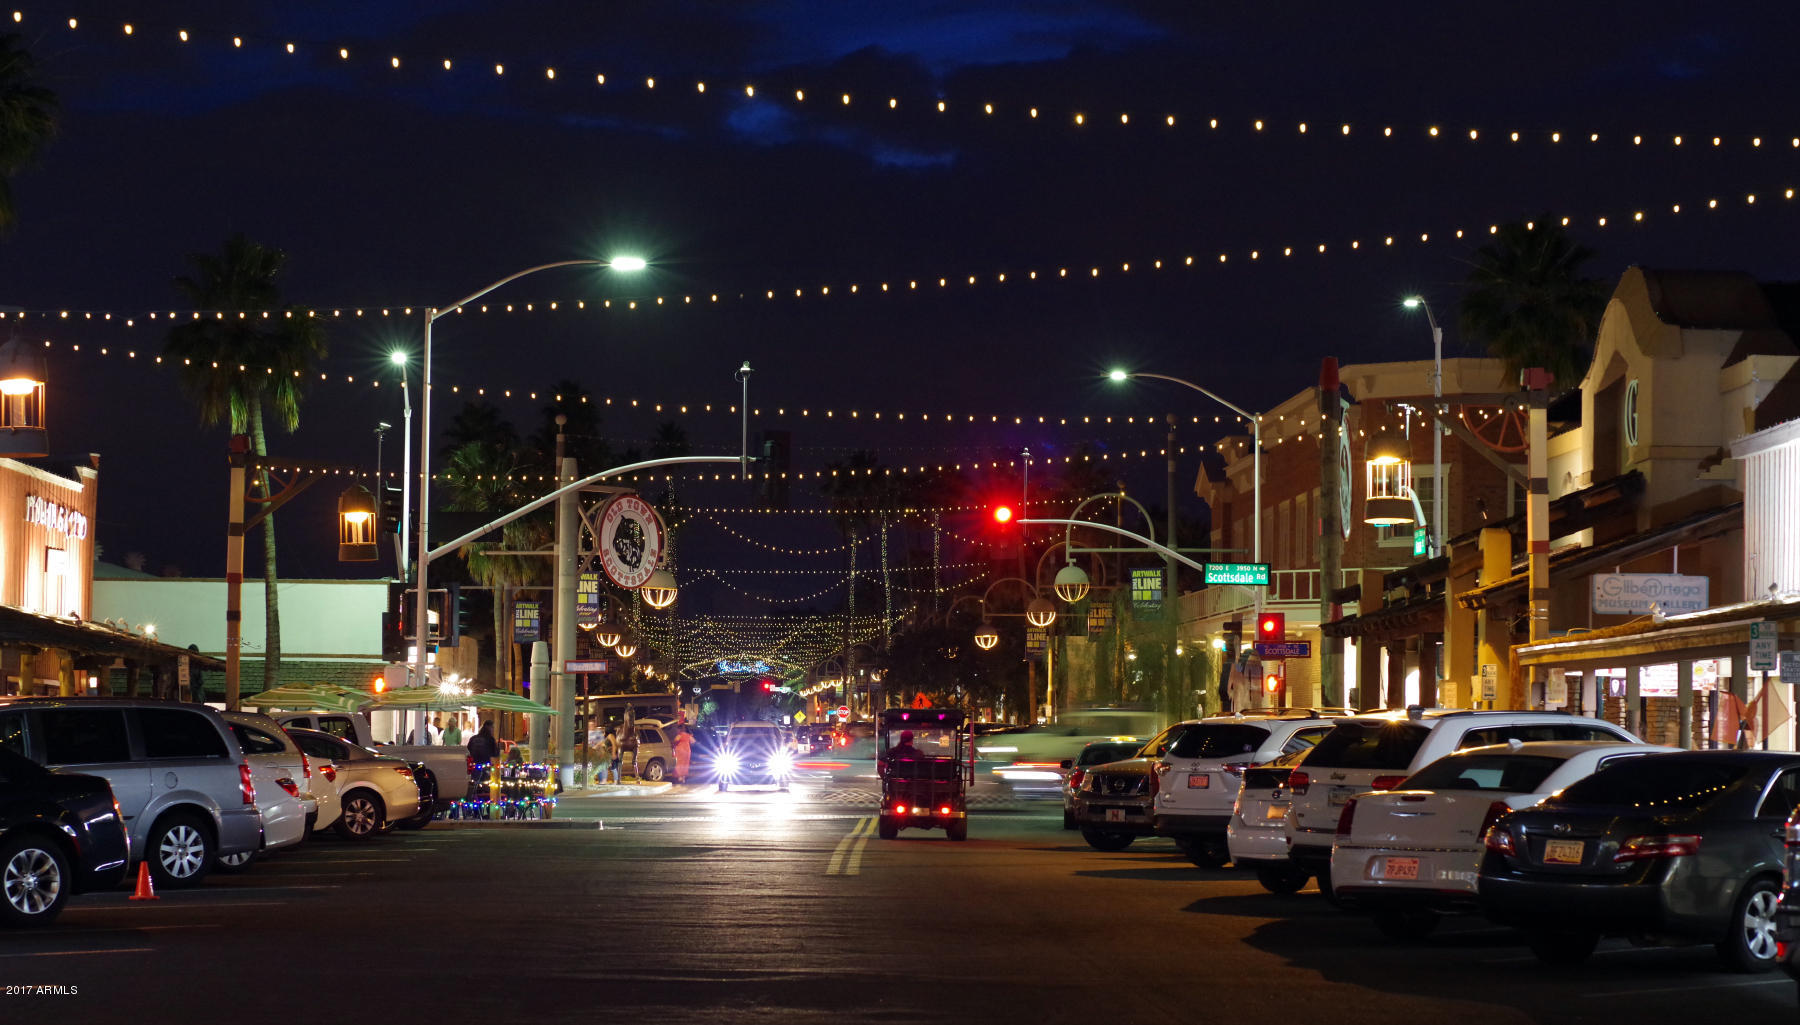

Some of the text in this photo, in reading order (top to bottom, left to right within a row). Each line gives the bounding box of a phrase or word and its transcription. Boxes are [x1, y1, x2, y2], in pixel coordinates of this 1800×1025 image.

[607, 499, 653, 525] OLD TOWN
[603, 548, 657, 586] SCOTTSDALE
[1208, 572, 1254, 583] Scottsdale
[1137, 578, 1161, 590] LINE
[1599, 600, 1648, 608] MUSEUM
[519, 609, 540, 618] LINE
